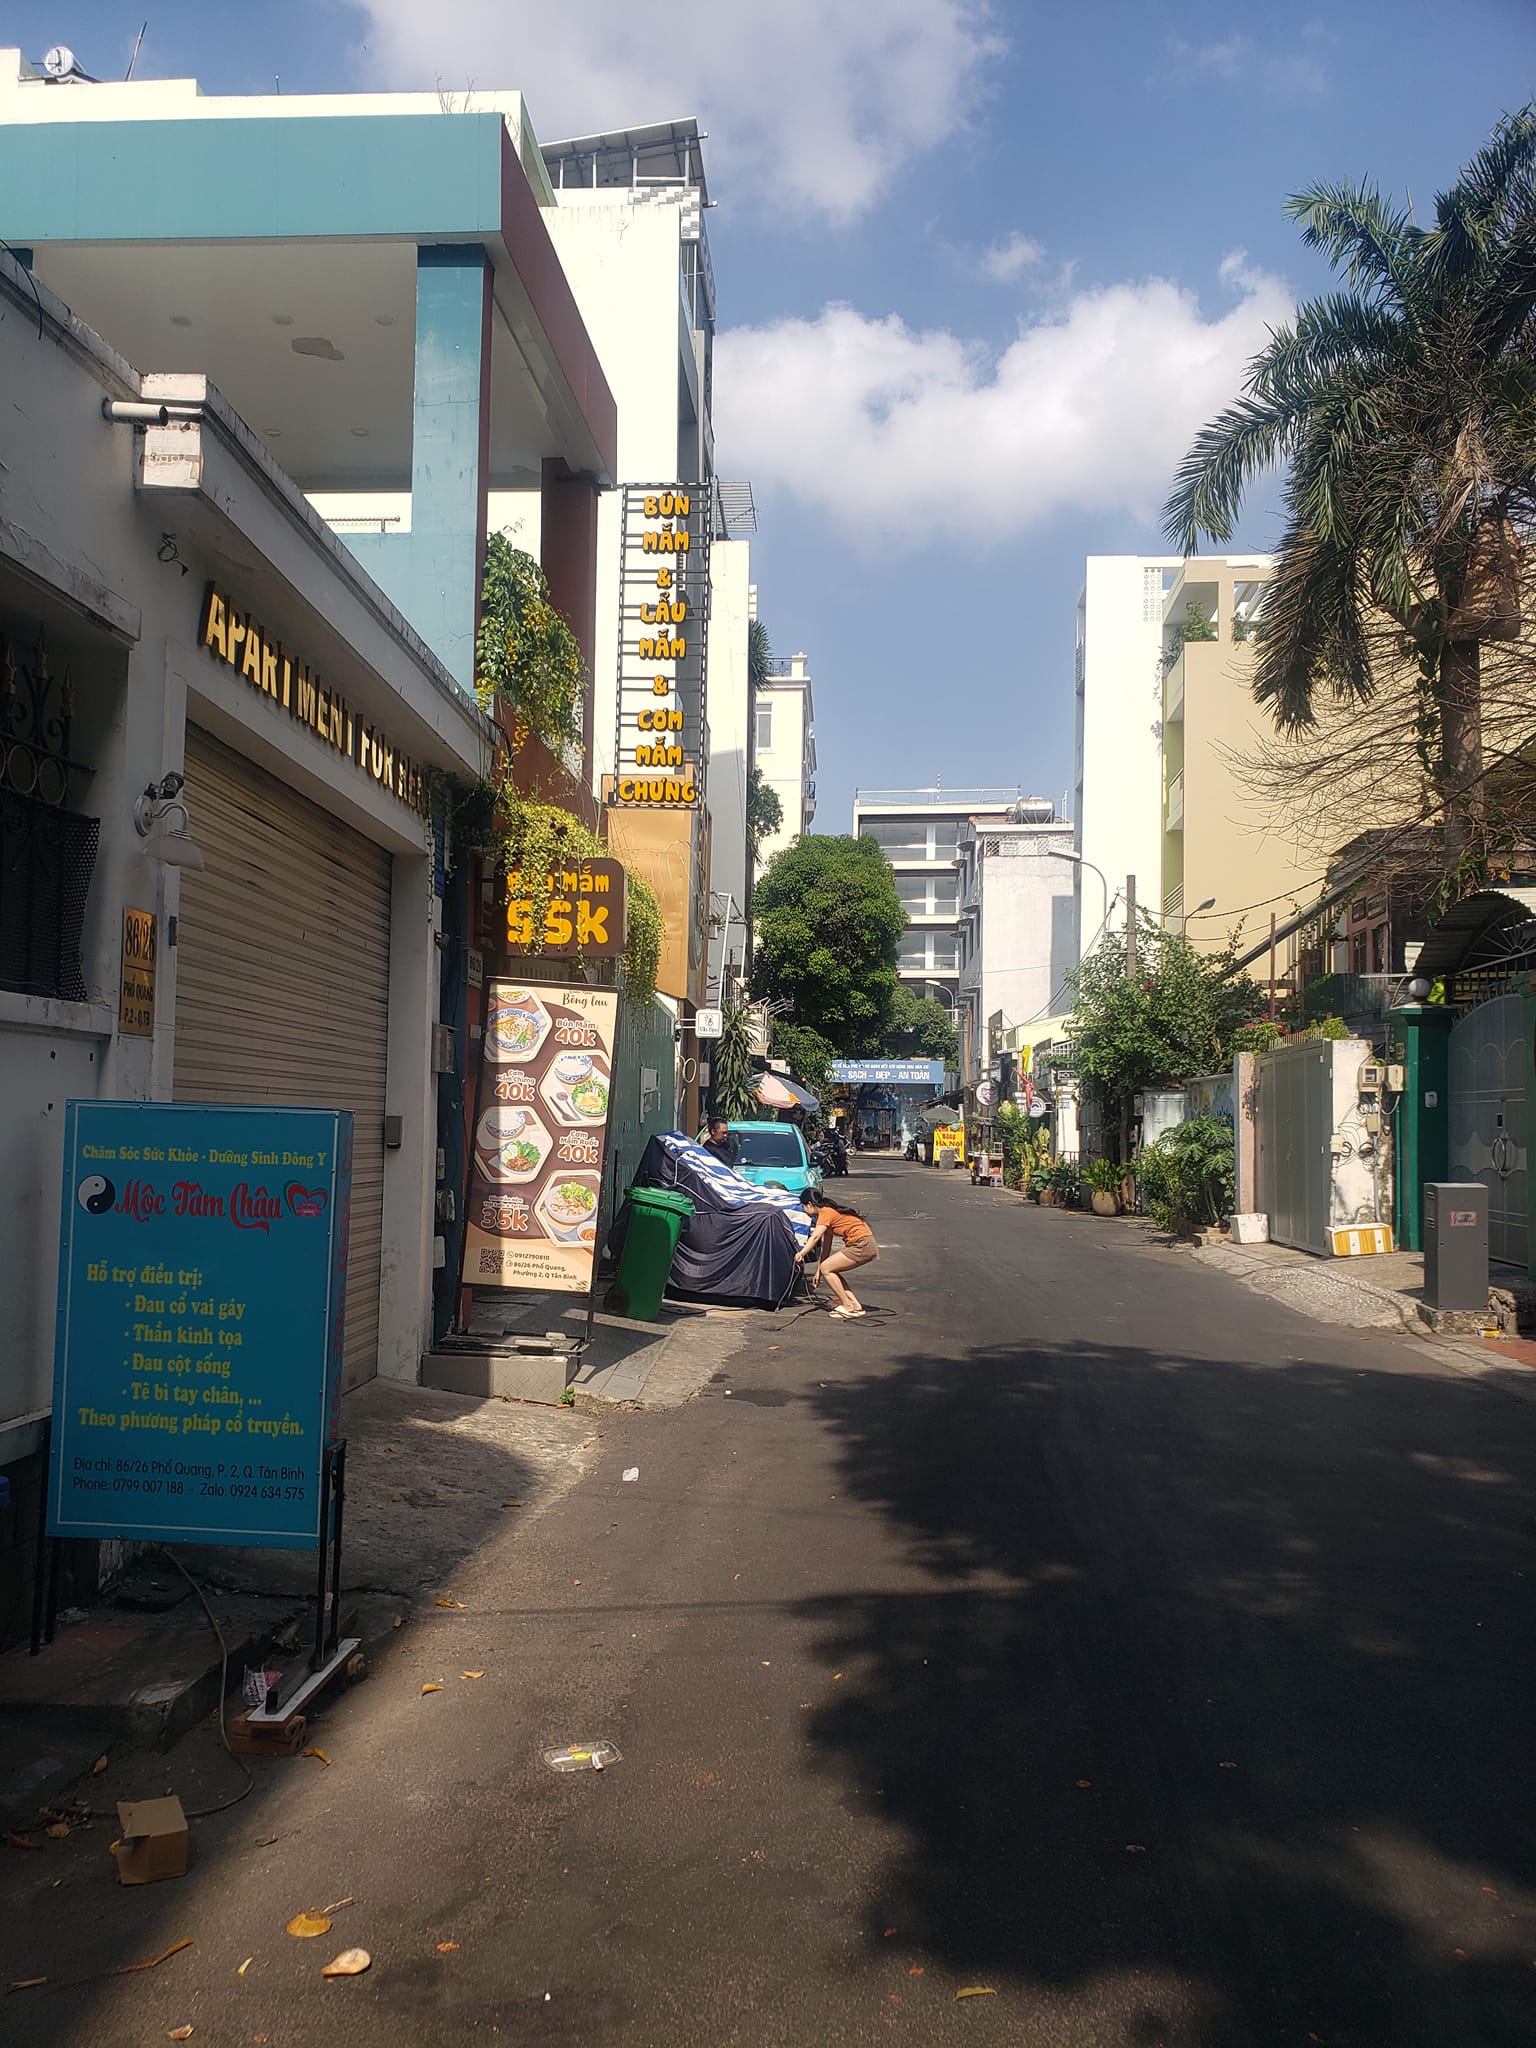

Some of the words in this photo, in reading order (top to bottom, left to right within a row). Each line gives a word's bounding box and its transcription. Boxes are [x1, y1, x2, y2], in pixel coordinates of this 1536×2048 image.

[643, 491, 691, 519] BÚN
[642, 522, 691, 554] MẮM
[656, 567, 673, 589] &
[640, 591, 687, 625] LẨU
[638, 628, 686, 660] MẮM
[652, 674, 669, 696] &
[637, 707, 684, 732] CƠM
[635, 736, 682, 767] MẮM
[619, 777, 696, 804] CHƯNG
[125, 916, 156, 962] 86/26
[82, 1144, 116, 1160] Chăm
[120, 1146, 140, 1160] Sóc
[143, 1147, 165, 1161] Sức
[209, 1149, 248, 1167] Dưỡng
[251, 1151, 279, 1165] Sinh
[282, 1152, 314, 1169] Đông
[317, 1152, 327, 1166] Y
[115, 1179, 166, 1222] Mộc
[171, 1180, 226, 1217] Tâm
[230, 1182, 283, 1235] Châu
[481, 1208, 528, 1231] 35k
[87, 1260, 107, 1282] Hỗ
[112, 1267, 137, 1288] trợ
[140, 1263, 174, 1284] điều
[134, 1295, 165, 1313] Đau
[169, 1291, 187, 1314] cổ
[191, 1299, 214, 1315] vai
[218, 1299, 246, 1320] gáy
[134, 1321, 172, 1342] Thần
[177, 1327, 213, 1345] kinh
[218, 1330, 243, 1350] tọa
[132, 1353, 163, 1371] Đau
[167, 1354, 191, 1377] cột
[195, 1352, 231, 1379] sống
[131, 1382, 150, 1400] Tê
[173, 1386, 199, 1406] tay
[202, 1386, 243, 1408] chân,
[79, 1408, 116, 1426] Theo
[120, 1411, 178, 1433] phương
[182, 1413, 221, 1434] pháp
[225, 1409, 243, 1433] cổ
[247, 1412, 304, 1438] truyền.
[73, 1457, 92, 1471] Địa
[116, 1459, 149, 1473] 86/26
[151, 1459, 173, 1474] Phổ
[174, 1461, 214, 1479] Quang,
[217, 1464, 227, 1477] P.
[230, 1465, 240, 1479] 2,
[258, 1466, 278, 1479] Tân
[73, 1477, 110, 1491] Phone:
[112, 1479, 140, 1492] 0799
[142, 1480, 163, 1493] 007
[165, 1480, 184, 1494] 188
[200, 1482, 228, 1497] Zalo:
[230, 1483, 257, 1498] 0924
[261, 1485, 281, 1499] 634
[284, 1486, 305, 1500] 575
